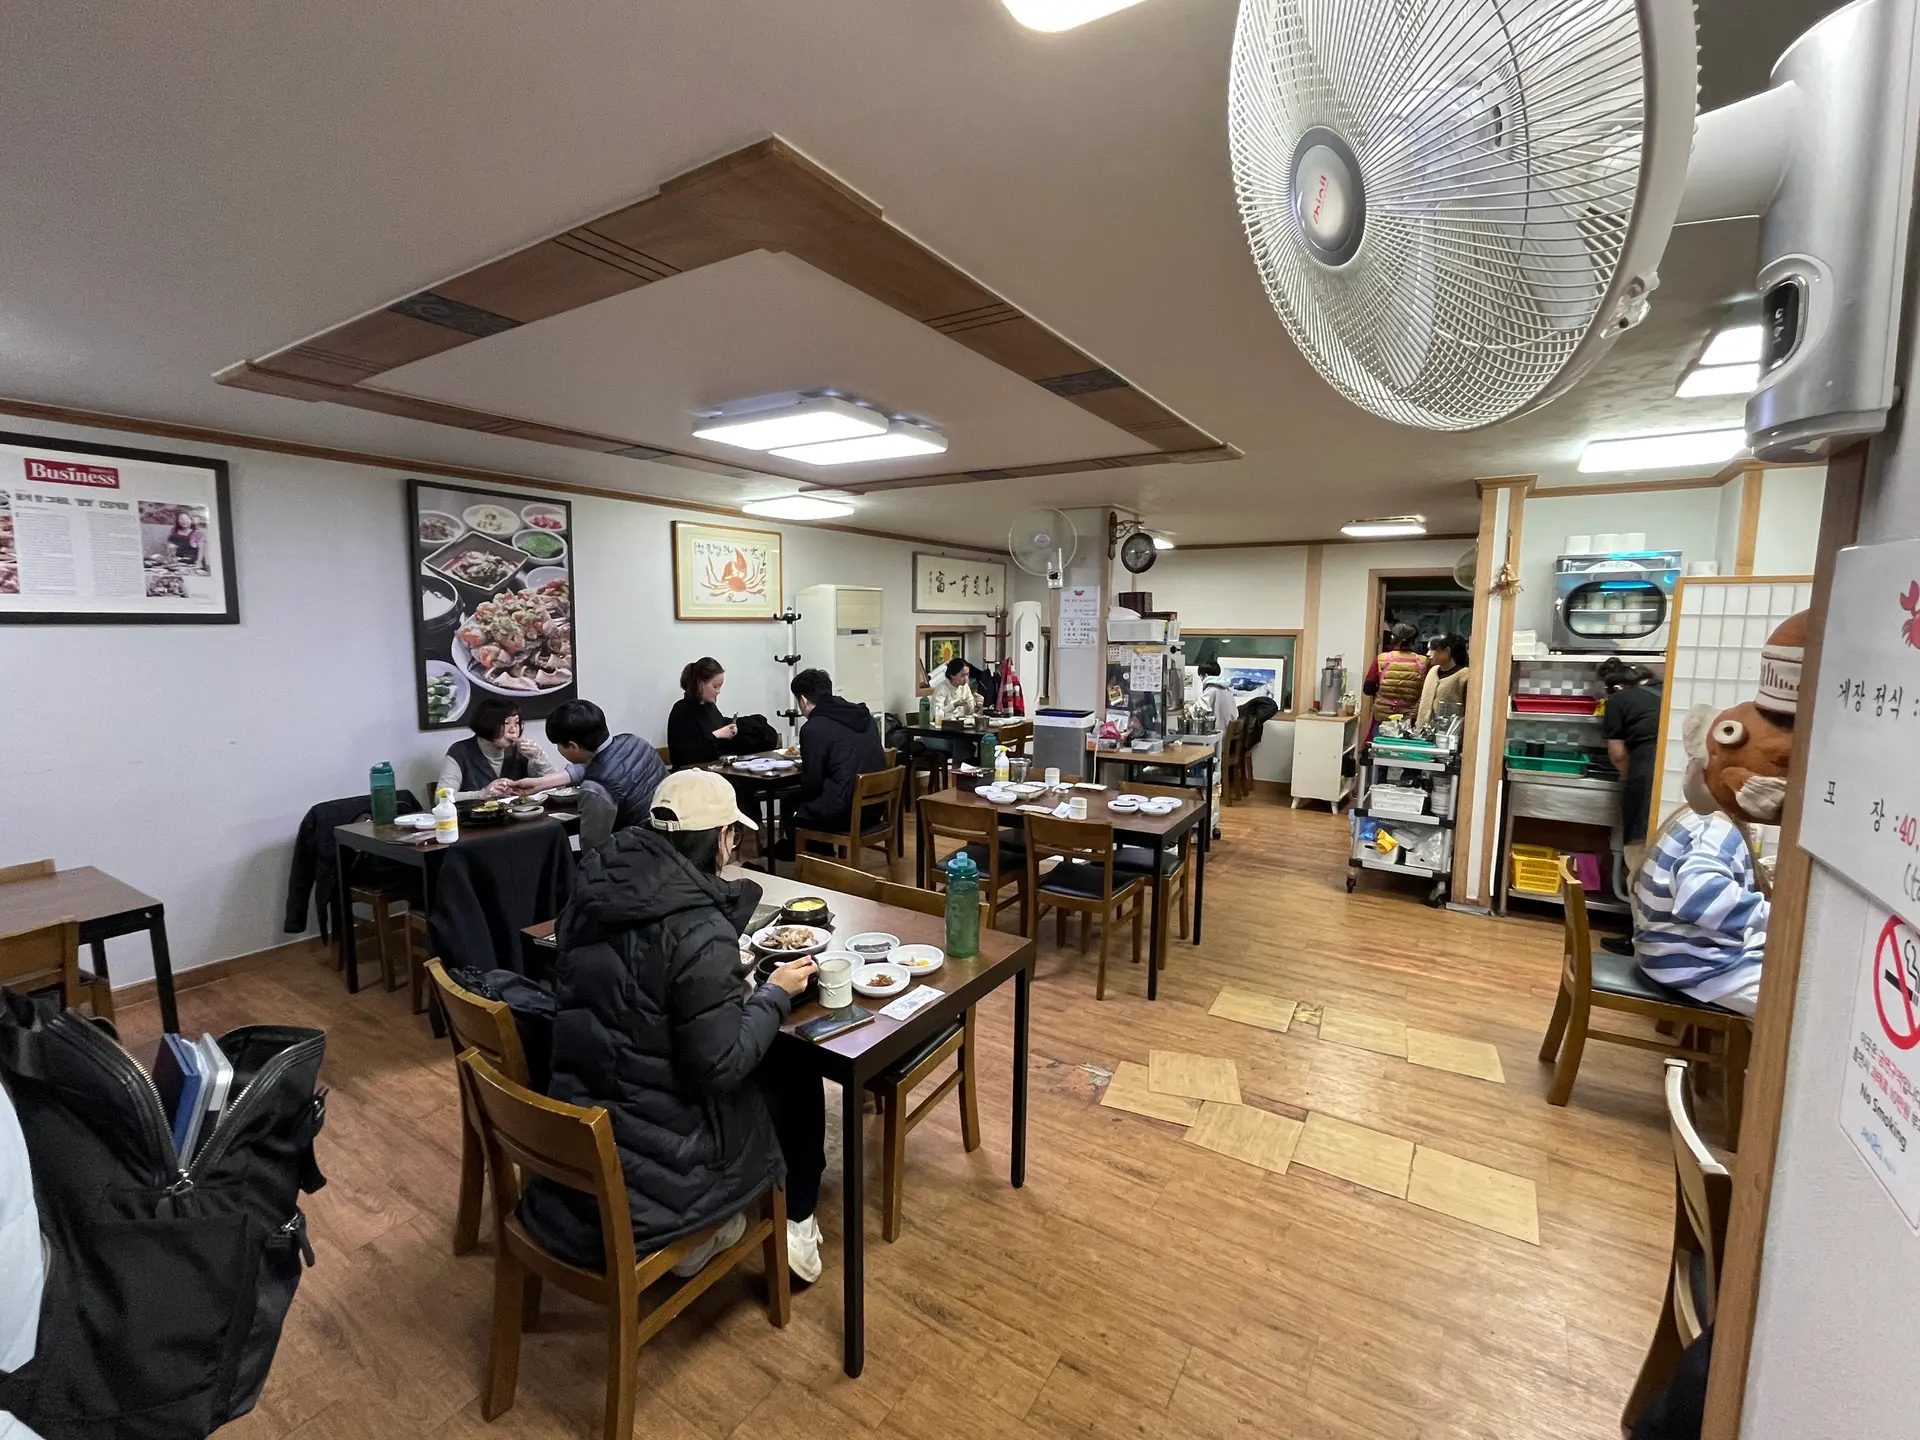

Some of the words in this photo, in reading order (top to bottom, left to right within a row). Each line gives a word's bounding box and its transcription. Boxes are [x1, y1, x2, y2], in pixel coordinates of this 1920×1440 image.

[30, 461, 116, 487] Business
[1838, 678, 1865, 712] 게장
[1872, 684, 1903, 720] 정식
[1860, 1082, 1871, 1104] No
[1872, 1097, 1907, 1152] Smoking
